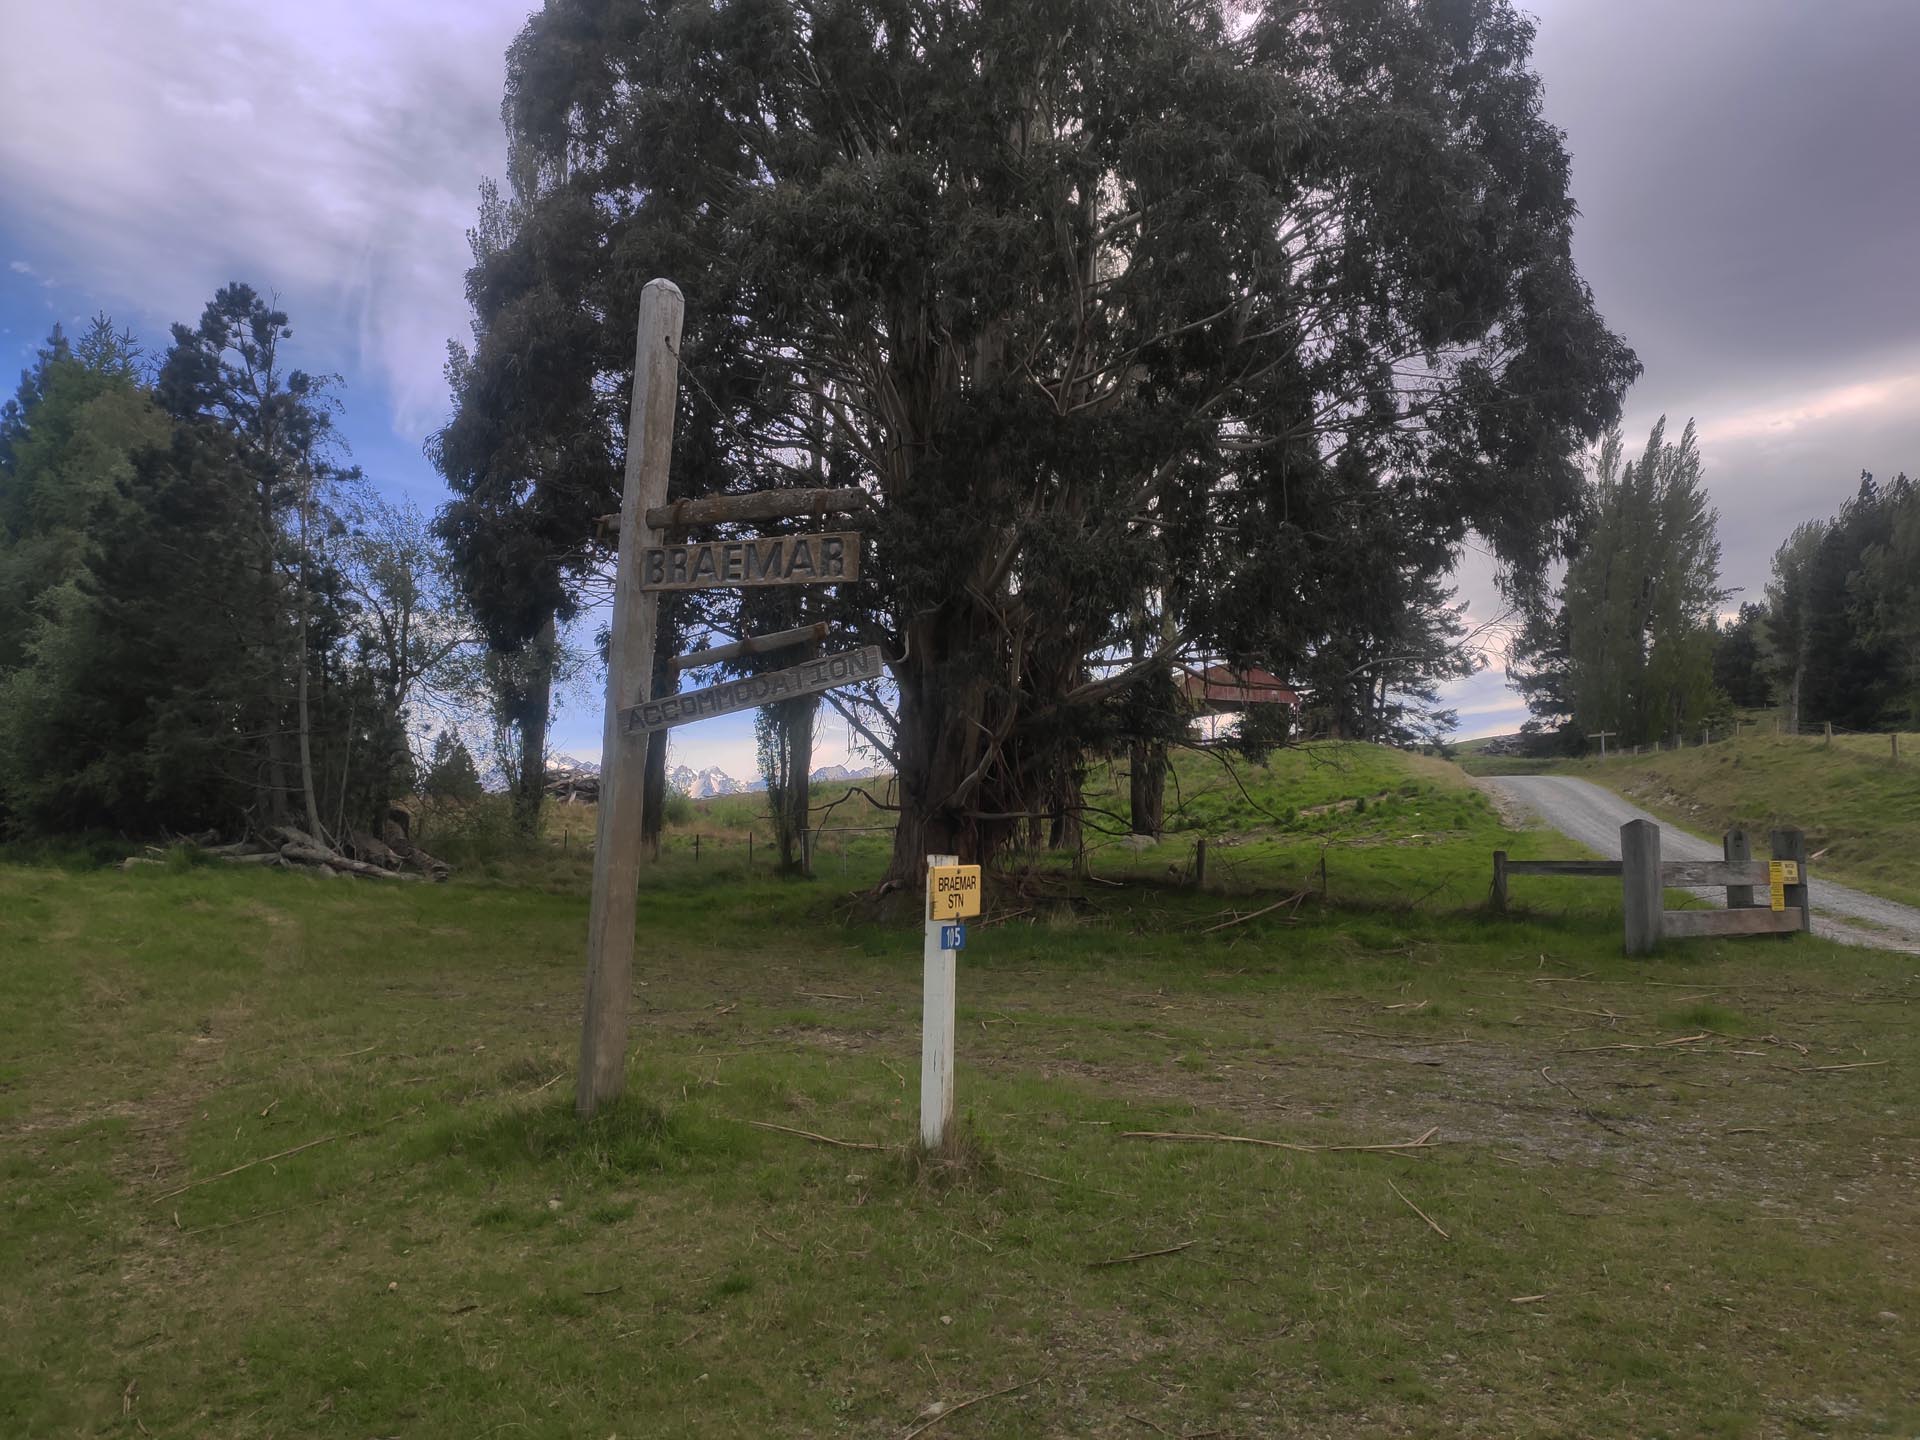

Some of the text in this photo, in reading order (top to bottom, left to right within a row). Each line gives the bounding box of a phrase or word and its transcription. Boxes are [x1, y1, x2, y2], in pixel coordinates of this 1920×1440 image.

[645, 537, 844, 584] BRAEMAR
[628, 650, 870, 731] ACCOMMODATION
[938, 875, 976, 892] BRAEMAR
[948, 894, 964, 909] STN
